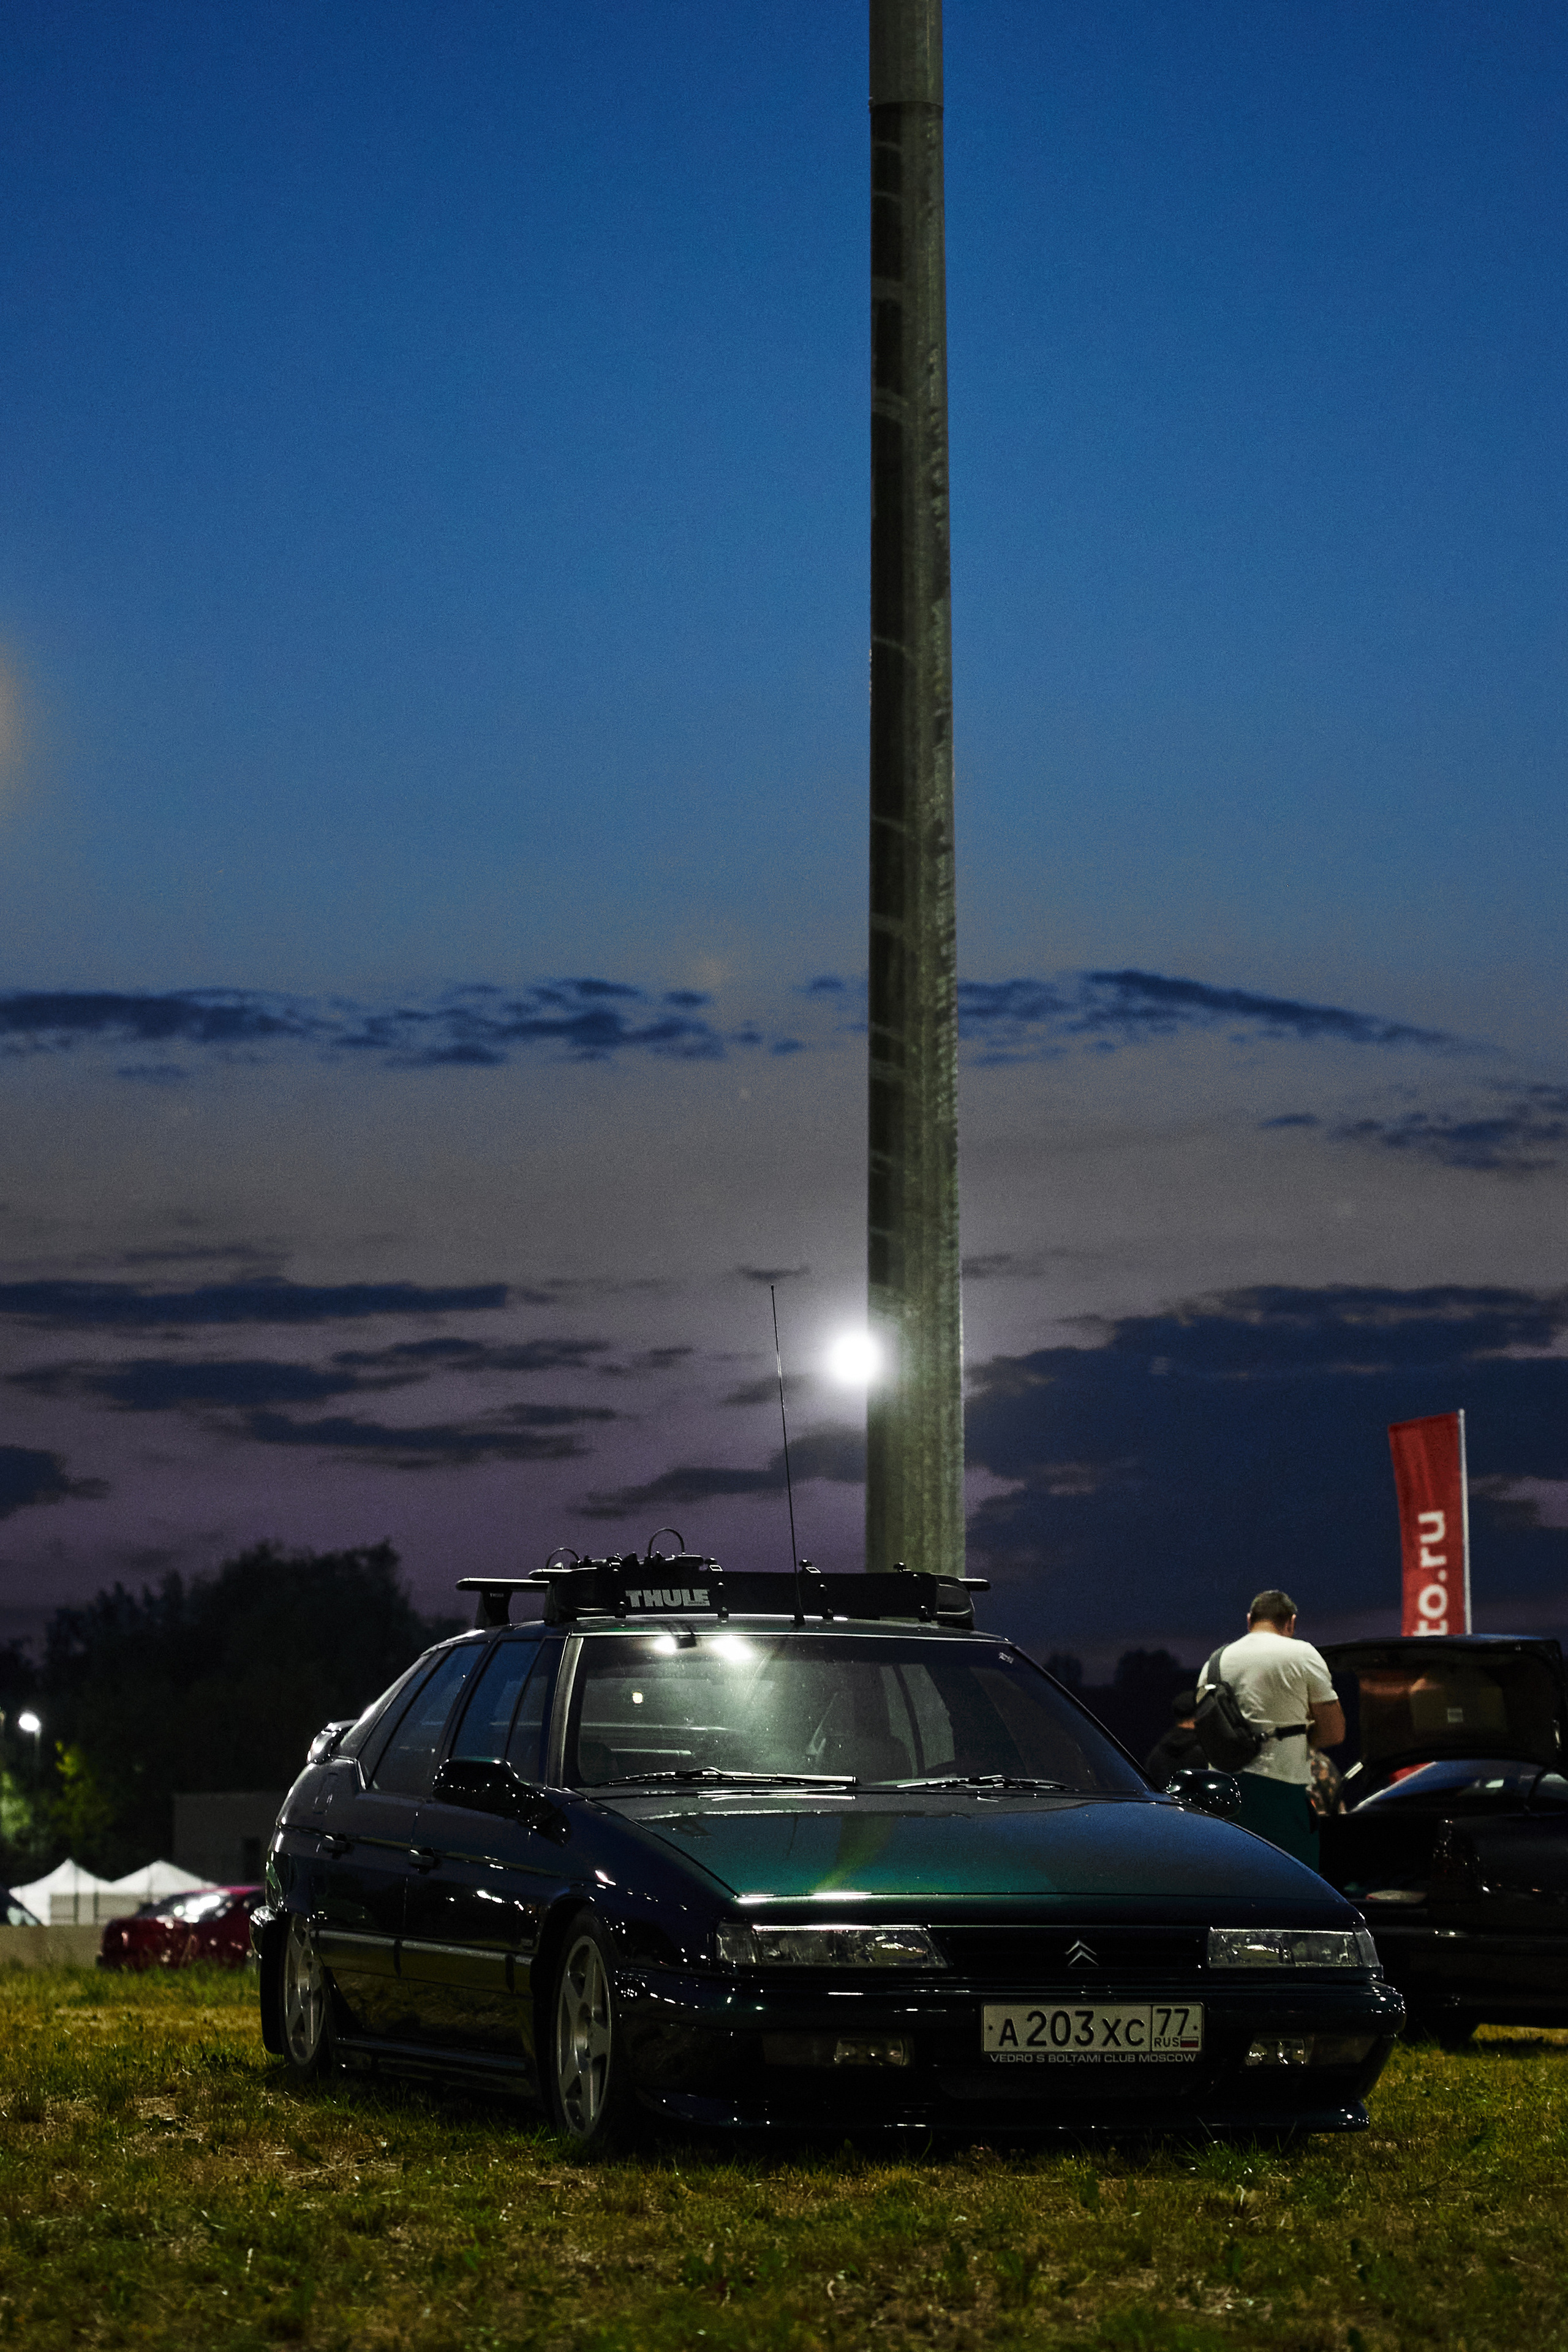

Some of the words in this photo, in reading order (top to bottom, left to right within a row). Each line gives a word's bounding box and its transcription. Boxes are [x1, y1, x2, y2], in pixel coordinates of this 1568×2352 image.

[625, 1588, 710, 1608] THULE
[1156, 2008, 1190, 2037] 77
[1154, 2037, 1179, 2048] RUS
[990, 2054, 1033, 2063] VEDRO
[1036, 2054, 1046, 2063] S
[1049, 2054, 1101, 2063] BOLTAMI
[1104, 2054, 1136, 2063] CLUB
[1138, 2054, 1196, 2063] MOSCOW
